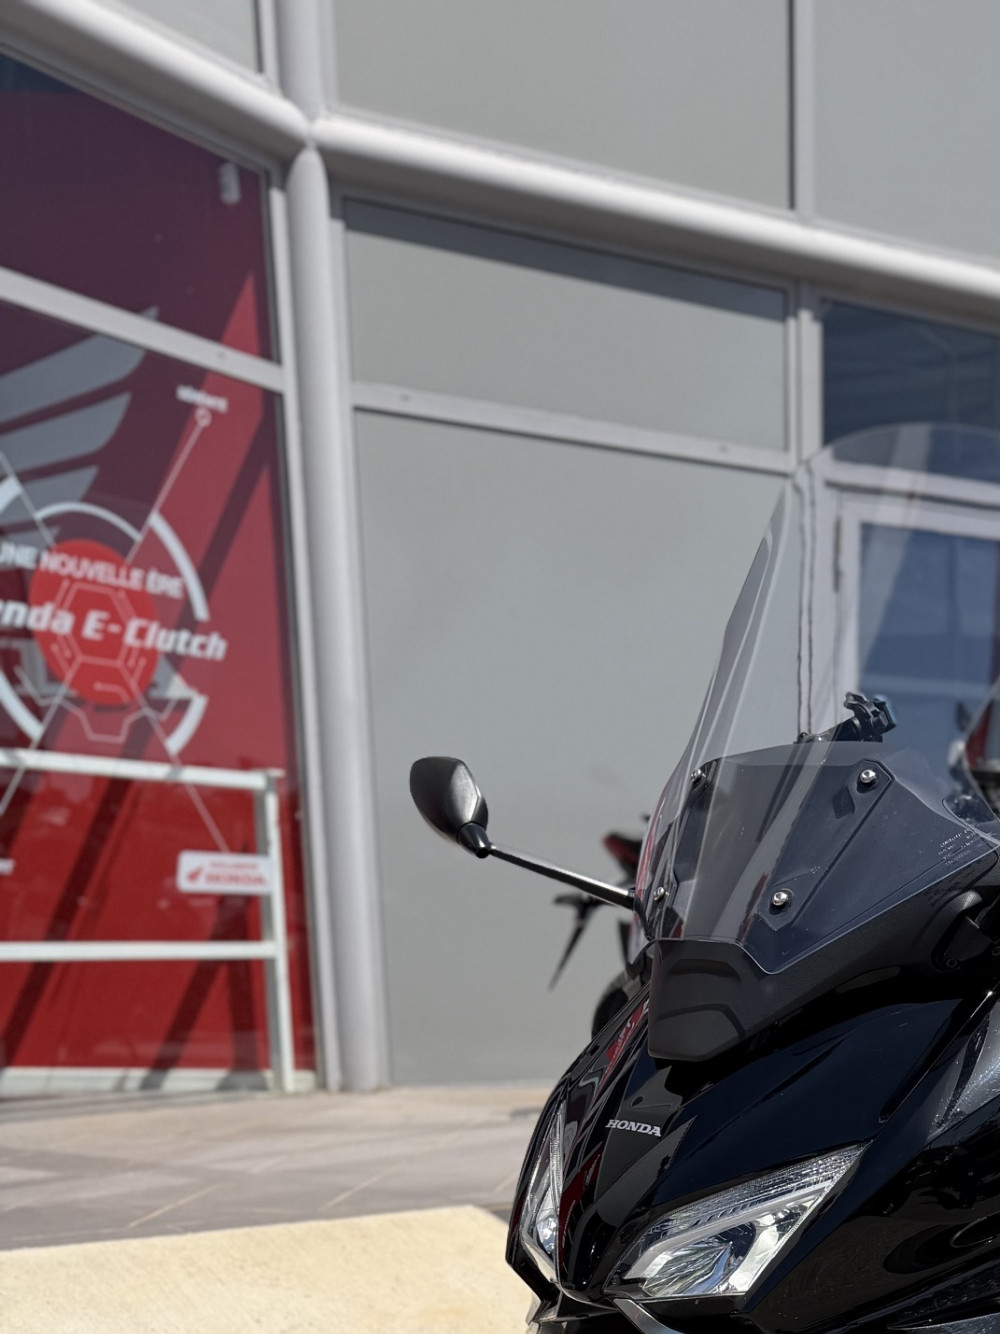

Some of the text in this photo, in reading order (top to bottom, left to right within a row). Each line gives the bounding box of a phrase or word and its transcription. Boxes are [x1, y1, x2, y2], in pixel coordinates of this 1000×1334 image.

[40, 550, 144, 592] NOUVELLE
[0, 599, 228, 661] nda E-Clutch
[605, 1119, 662, 1138] HONDA
